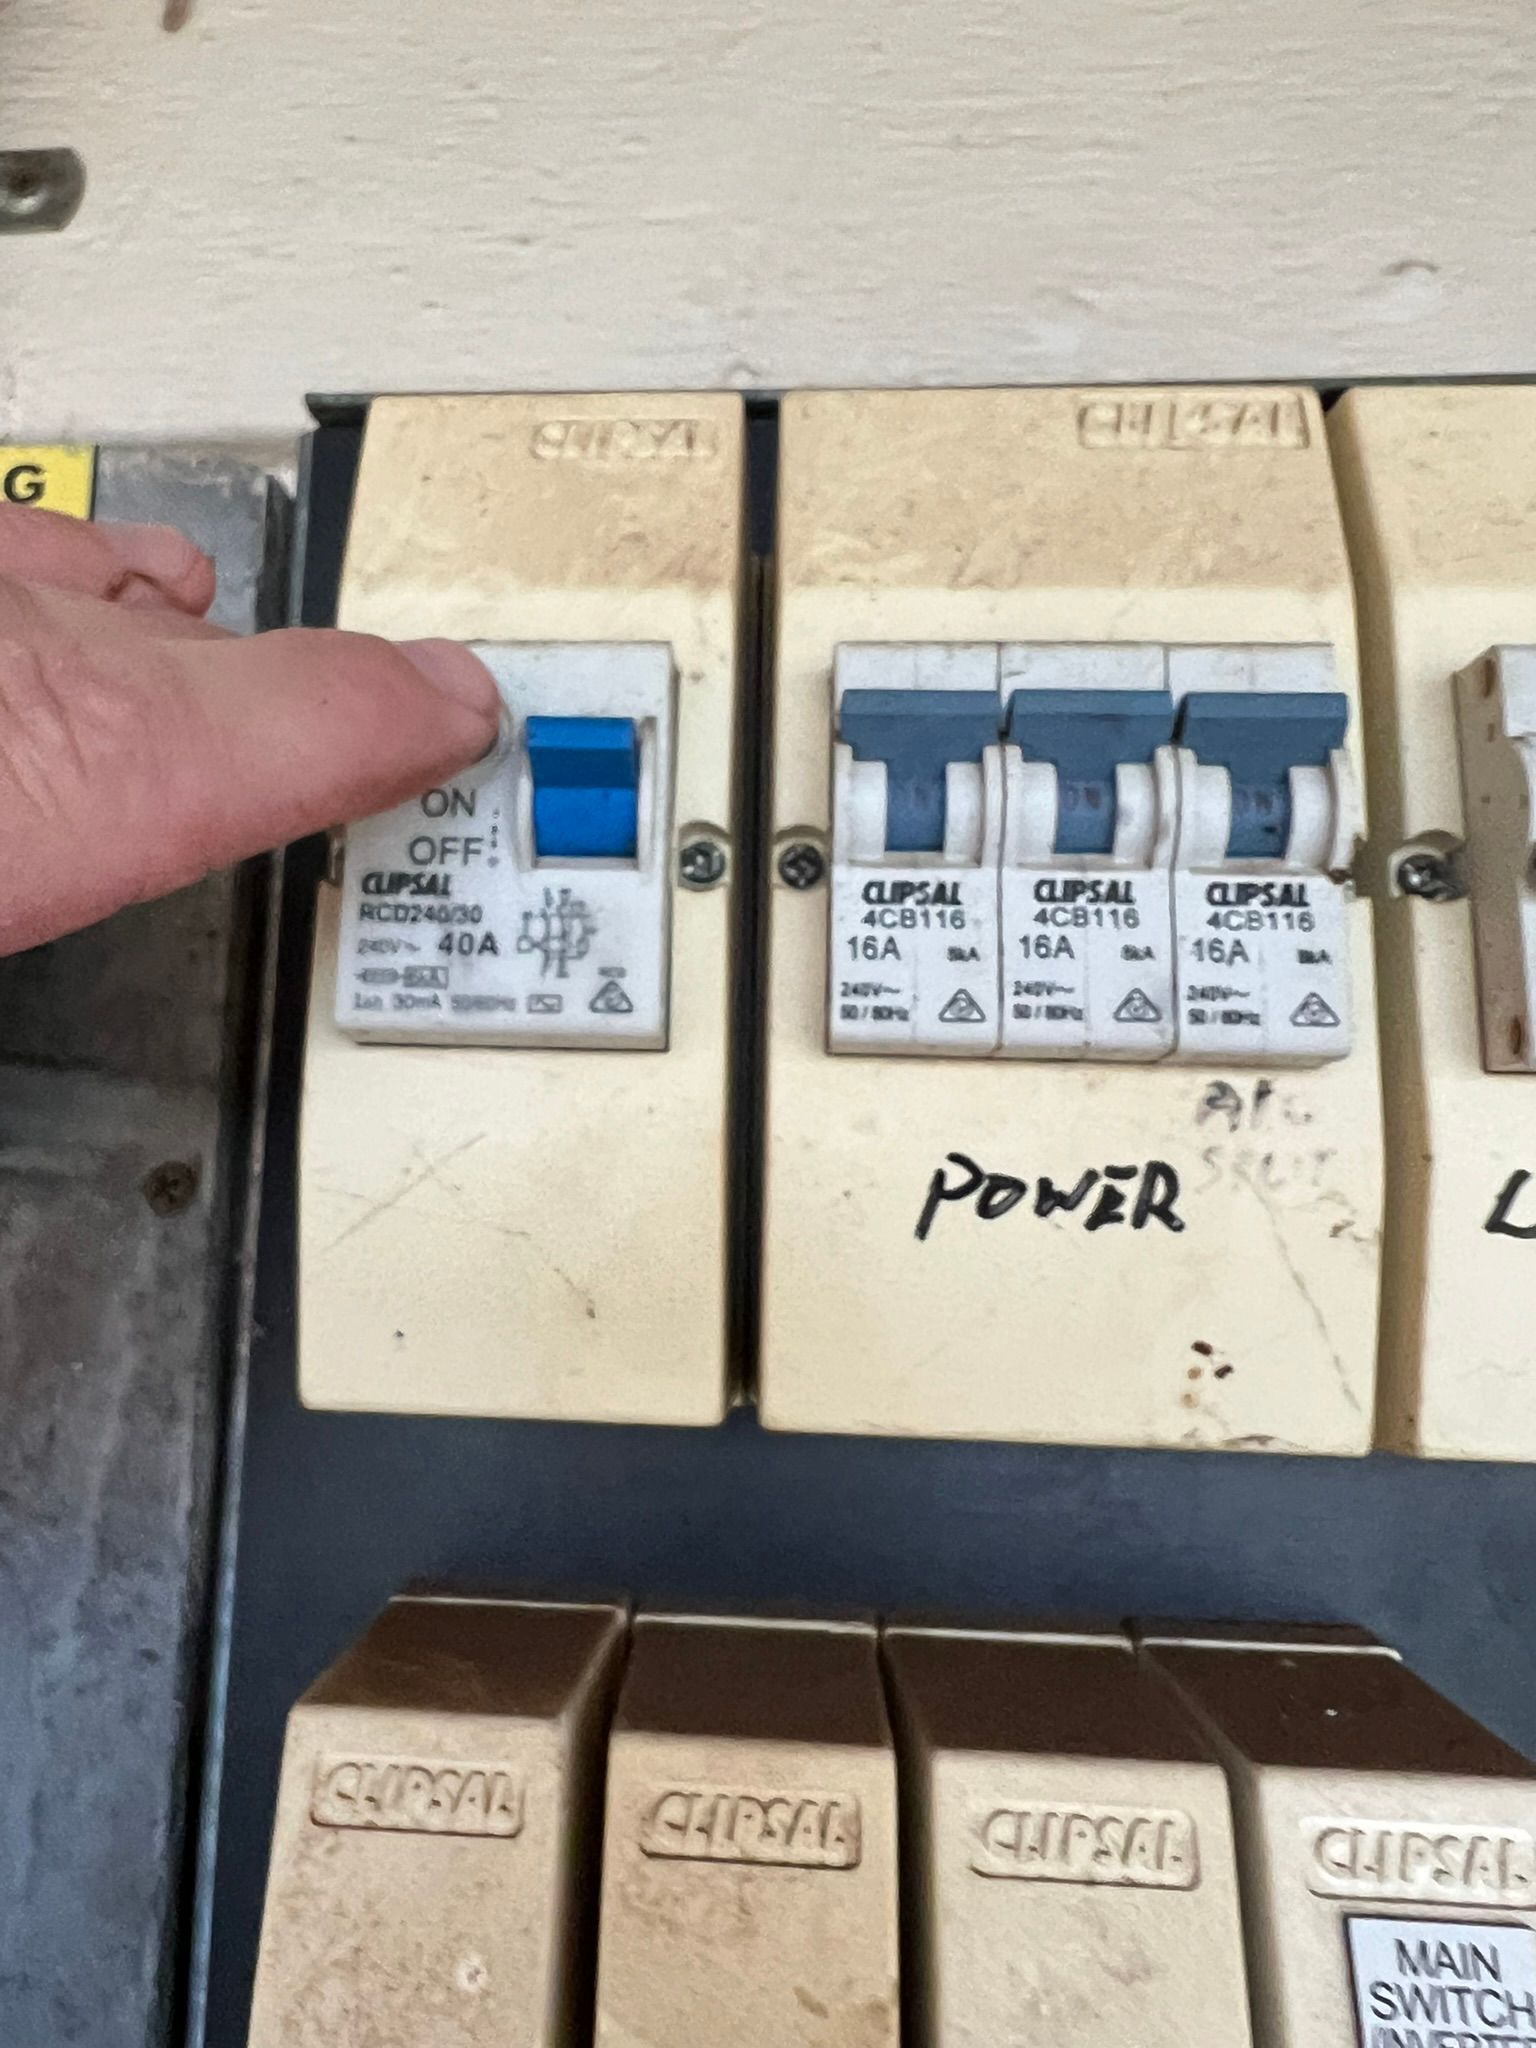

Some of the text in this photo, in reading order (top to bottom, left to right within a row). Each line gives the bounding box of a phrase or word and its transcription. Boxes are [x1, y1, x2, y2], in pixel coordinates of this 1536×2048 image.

[420, 788, 476, 817] ON
[408, 836, 484, 865] OFF
[861, 907, 966, 929] 4CB116
[1033, 906, 1140, 929] 4CB116
[1206, 909, 1315, 933] 4CB116
[438, 932, 499, 957] 40A
[847, 935, 902, 960] 16A
[1019, 934, 1075, 959] 16A
[1192, 937, 1249, 966] 16A
[914, 1152, 1186, 1241] POWER
[325, 1762, 514, 1819] CLIPSAL
[652, 1790, 850, 1852] CLIPSAL
[980, 1810, 1184, 1869] CLIPSAL
[1313, 1826, 1531, 1889] CLIPSAL
[1394, 1938, 1502, 1982] MAIN
[1369, 1980, 1536, 2028] SWITCH
